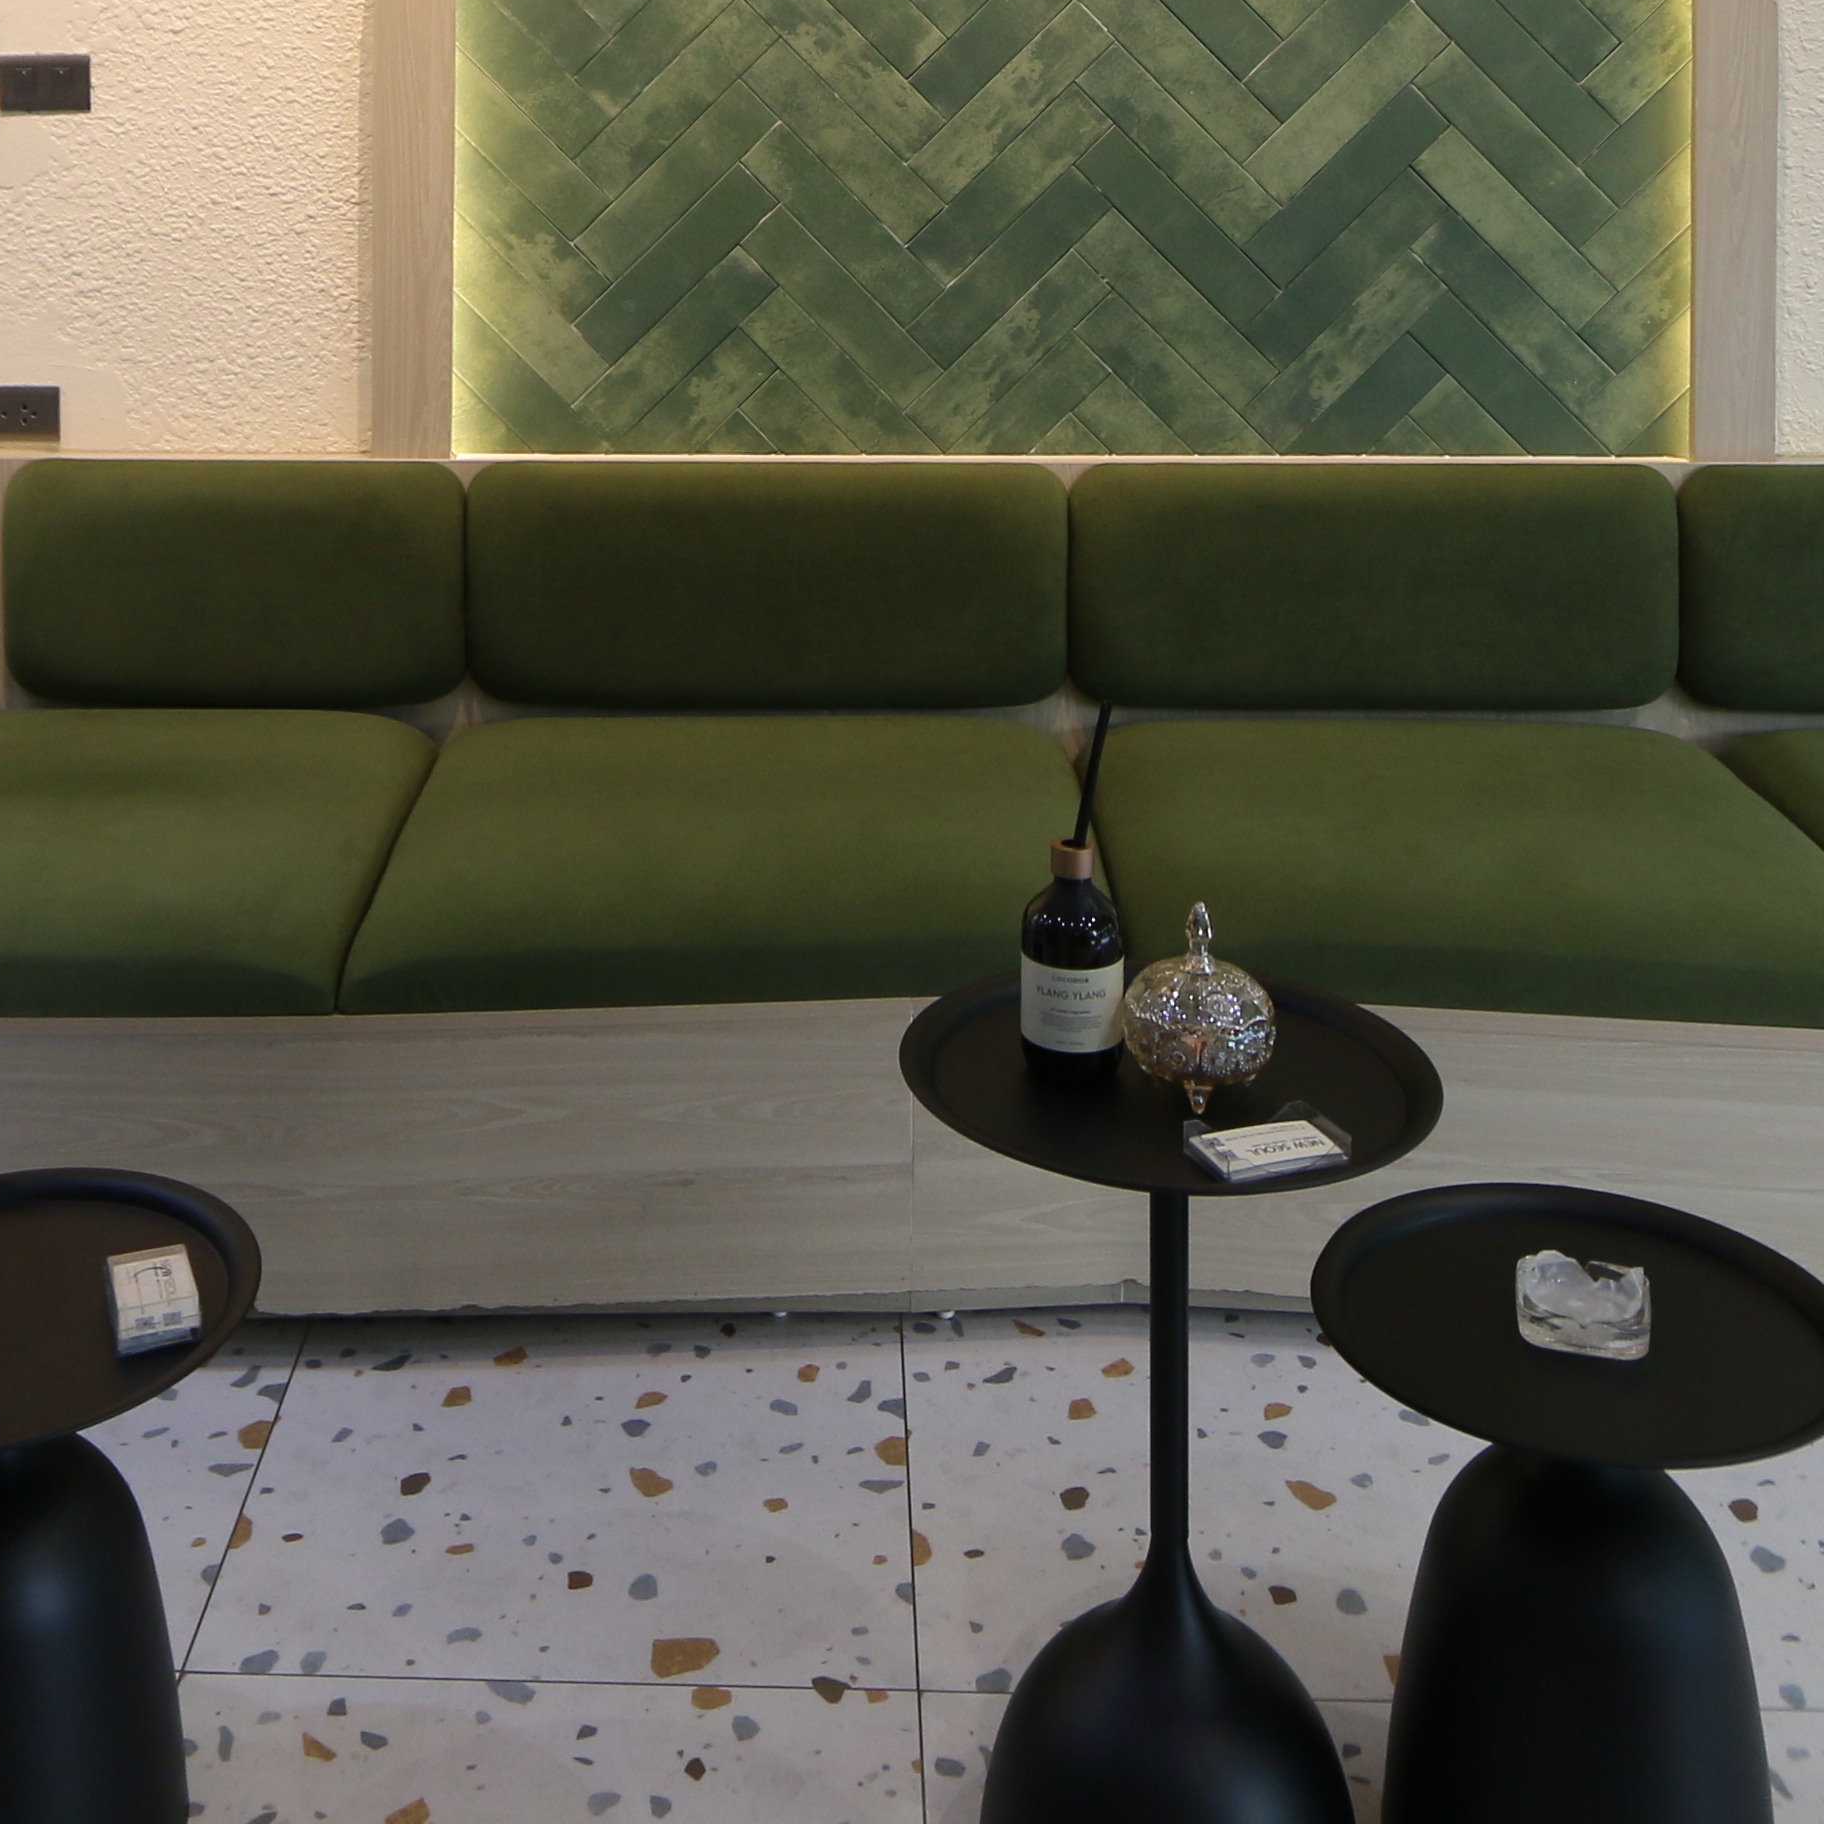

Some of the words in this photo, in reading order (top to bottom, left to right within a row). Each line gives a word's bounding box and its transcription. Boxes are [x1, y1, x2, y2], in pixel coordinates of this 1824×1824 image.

[1036, 985, 1069, 1000] YLANG
[1245, 1143, 1292, 1157] SEOUL
[1293, 1139, 1326, 1151] NEW
